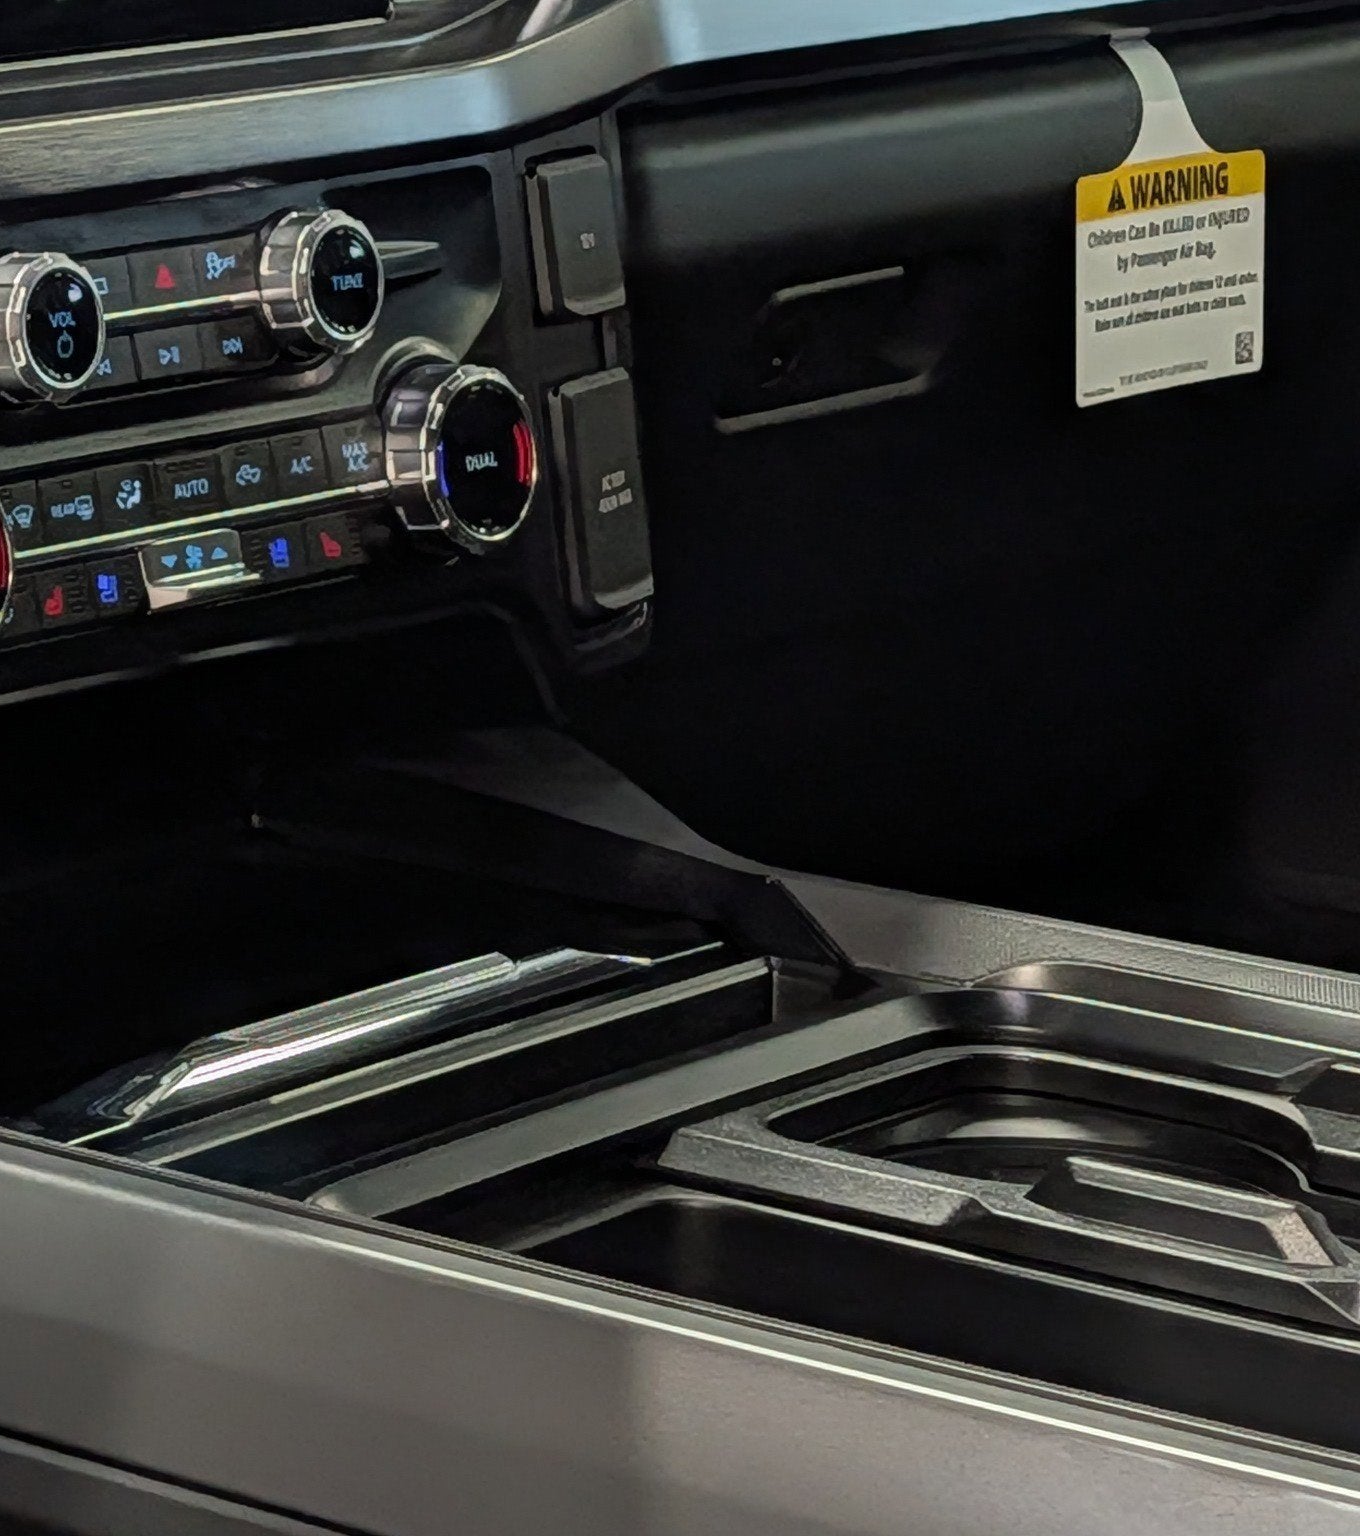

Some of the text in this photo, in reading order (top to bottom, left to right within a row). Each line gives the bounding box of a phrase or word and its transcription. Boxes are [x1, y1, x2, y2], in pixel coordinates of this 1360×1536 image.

[1130, 161, 1229, 211] WARNING
[1088, 229, 1126, 249] Children
[48, 311, 76, 328] VOL
[174, 477, 210, 500] AUTO
